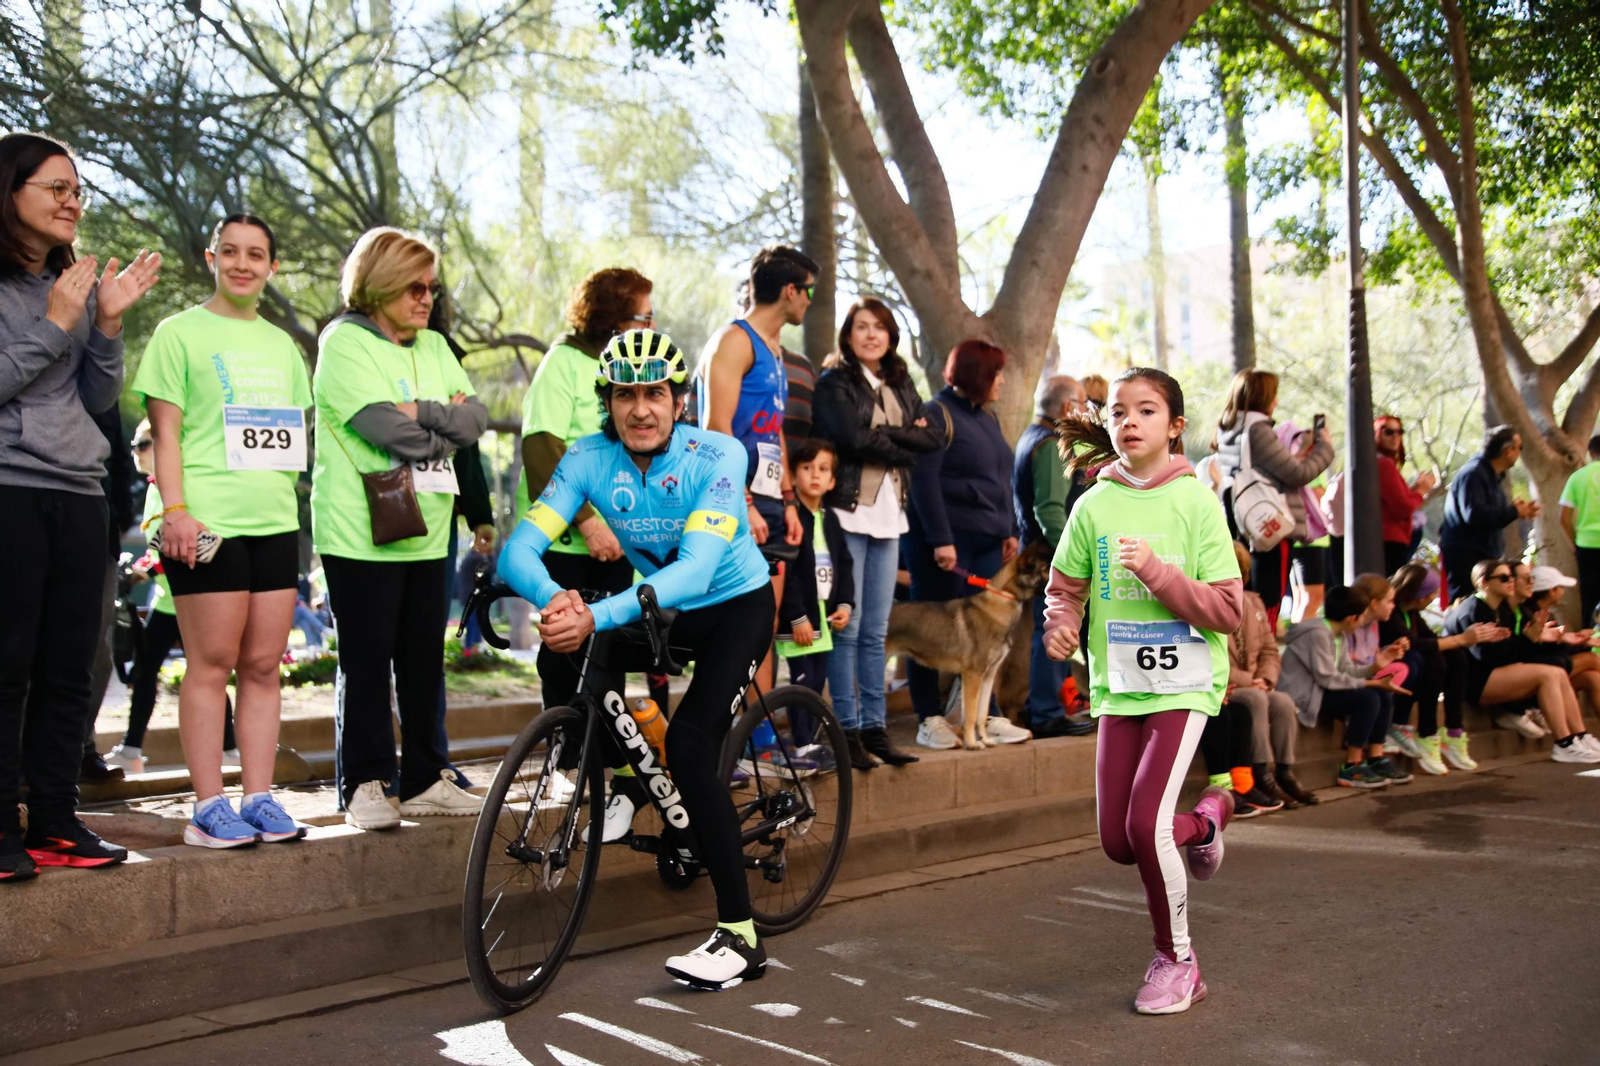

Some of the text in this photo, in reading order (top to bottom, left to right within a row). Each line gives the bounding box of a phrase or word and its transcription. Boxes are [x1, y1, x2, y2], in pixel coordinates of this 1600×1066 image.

[242, 428, 292, 450] 829
[630, 533, 682, 543] ALMERÍA
[1096, 535, 1111, 601] ALMERÍA
[1110, 624, 1137, 632] Almería
[1136, 645, 1179, 671] 65
